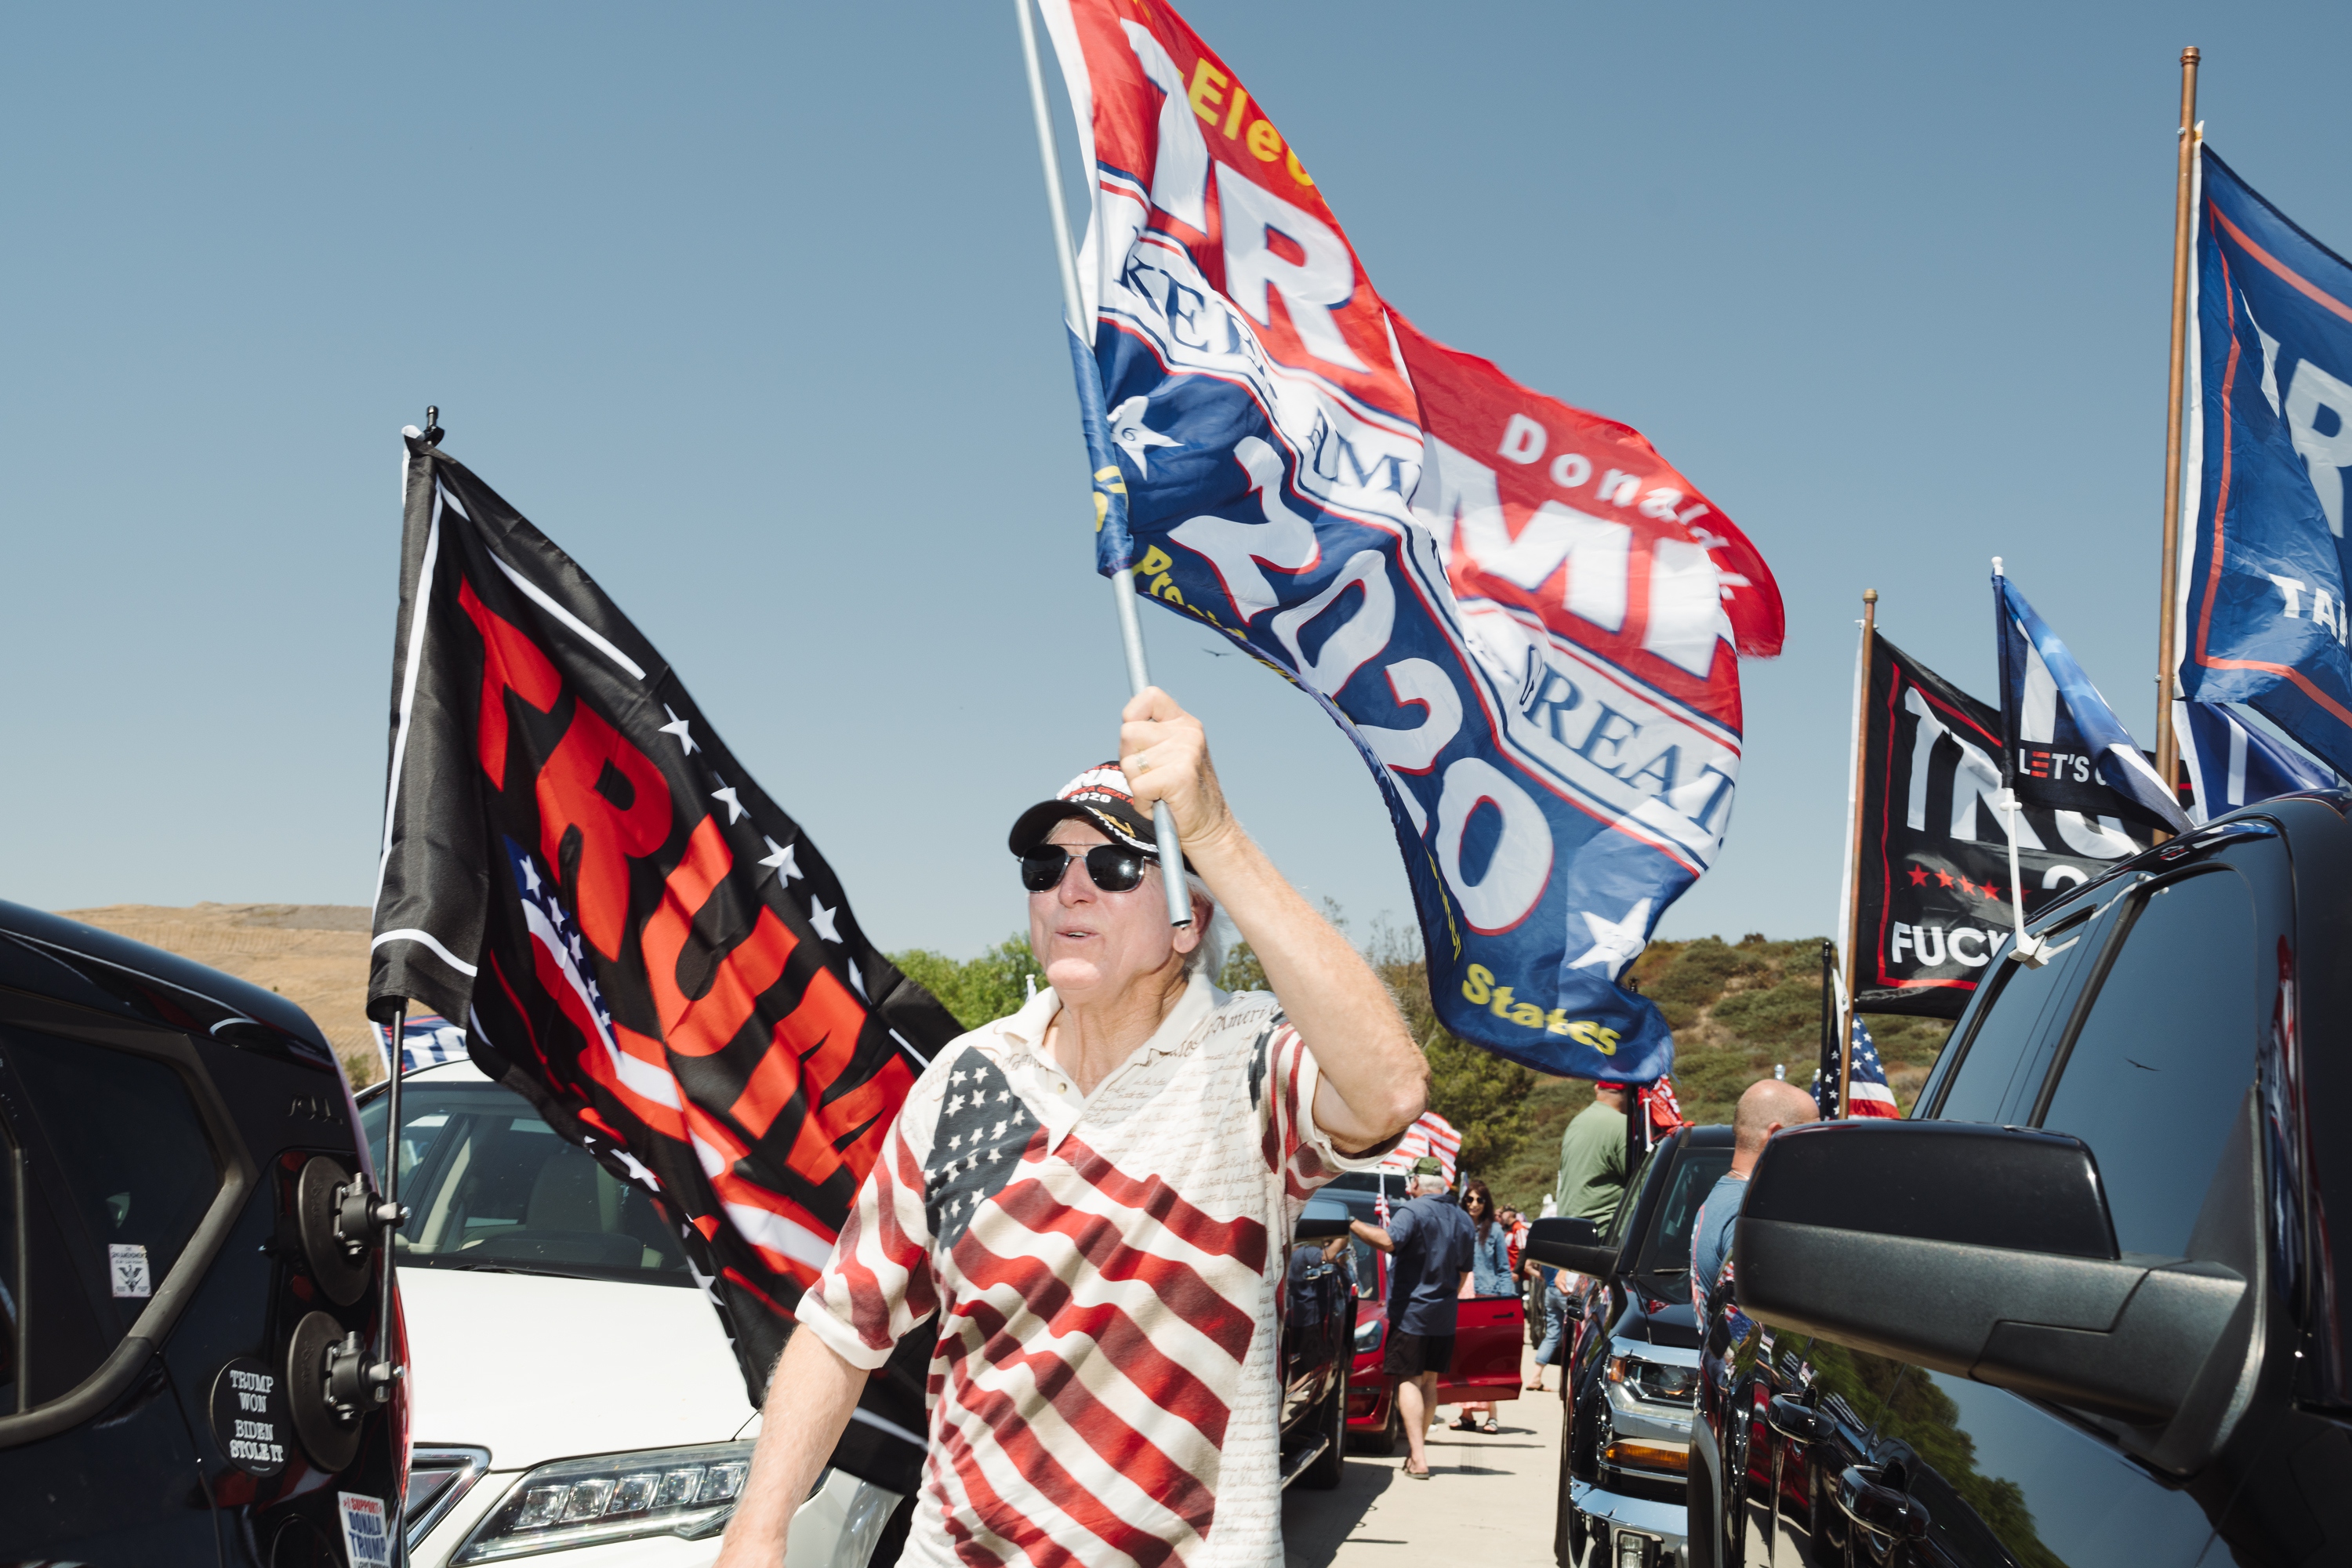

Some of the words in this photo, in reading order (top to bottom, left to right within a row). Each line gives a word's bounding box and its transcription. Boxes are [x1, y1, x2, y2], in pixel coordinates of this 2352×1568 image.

[1519, 643, 1735, 850] REAT
[2019, 746, 2091, 783] LET'S
[1070, 792, 1112, 803] 2020
[1096, 785, 1129, 800] GREAT
[457, 572, 917, 1208] TRUM
[1461, 963, 1622, 1056] States
[229, 1370, 274, 1393] TRUMP
[238, 1392, 267, 1414] WON
[234, 1419, 274, 1442] BIDEN
[229, 1439, 270, 1462] STOLE
[269, 1444, 285, 1463] IT
[348, 1511, 383, 1536] DONALD
[348, 1530, 387, 1562] TRUMP
